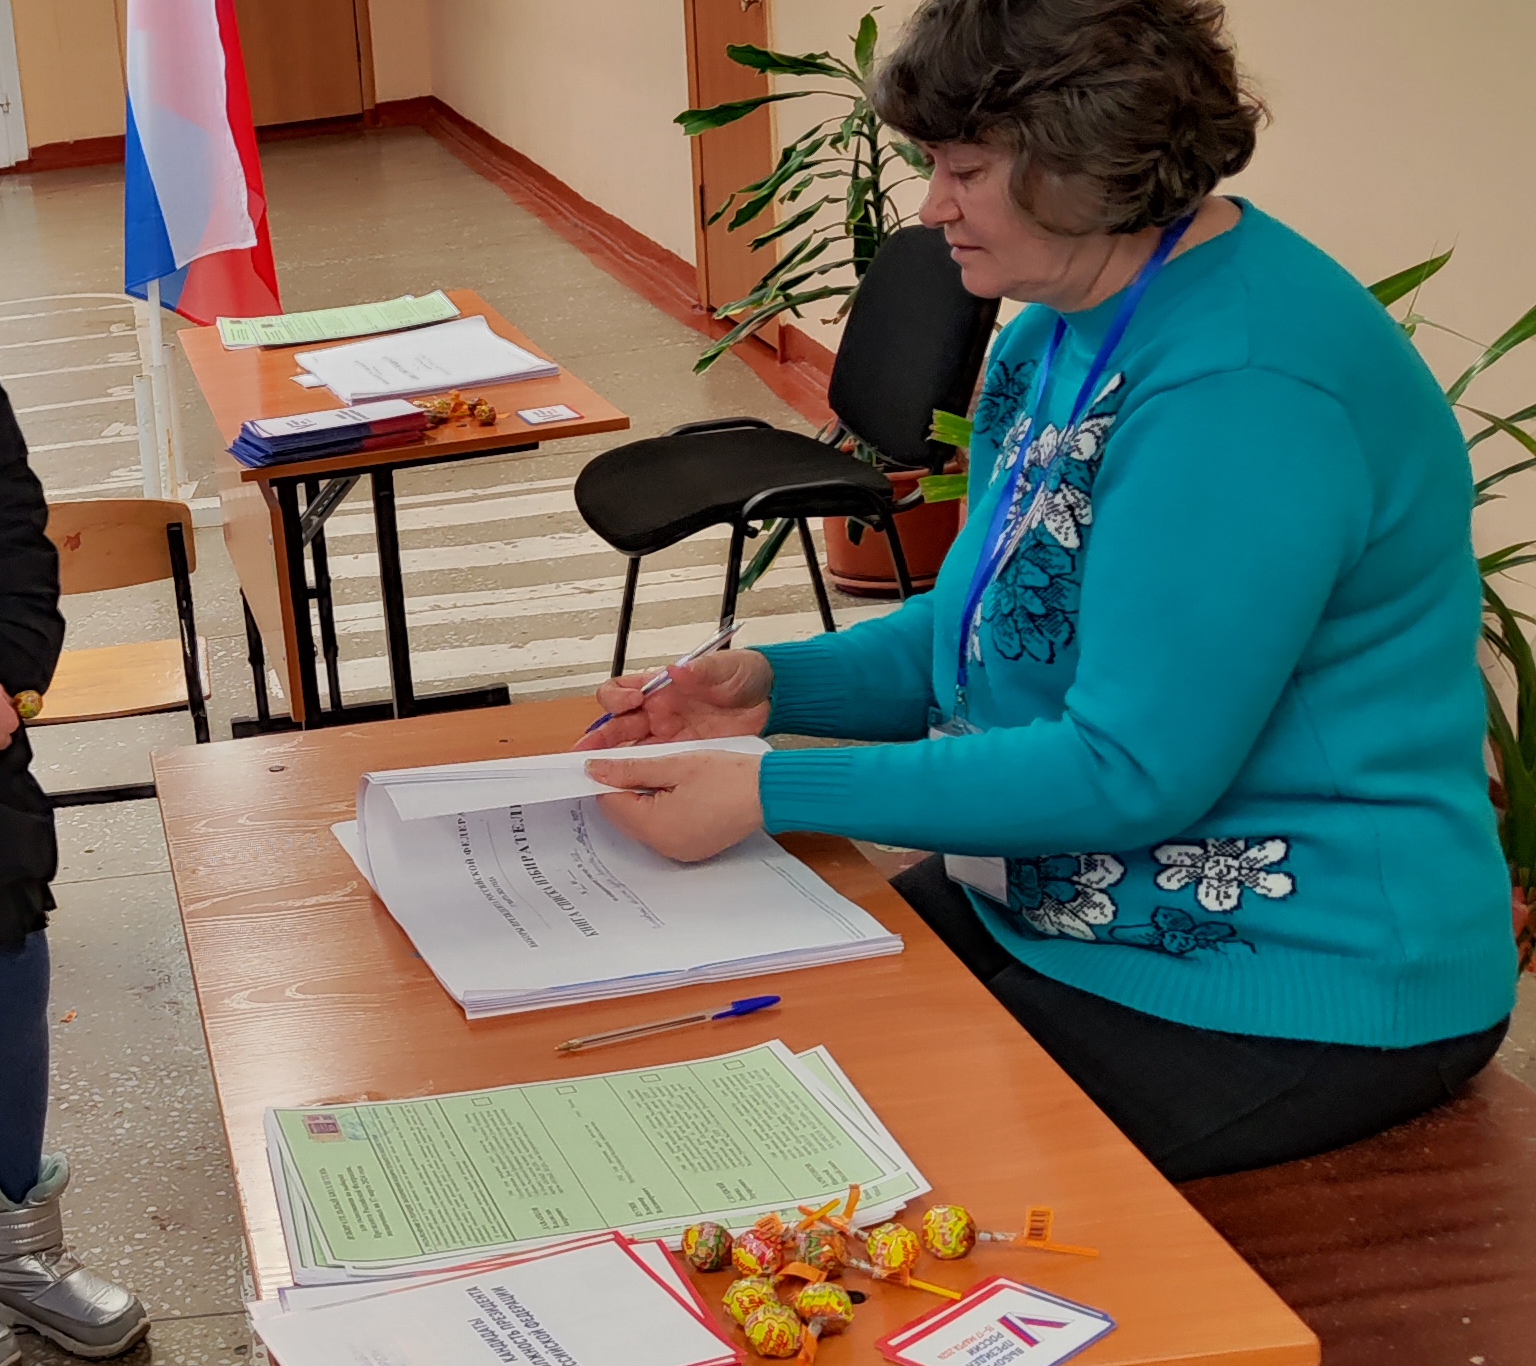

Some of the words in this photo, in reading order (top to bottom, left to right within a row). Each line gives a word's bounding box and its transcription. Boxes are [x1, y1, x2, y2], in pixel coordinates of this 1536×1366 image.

[465, 1285, 516, 1331] ПРЕЗИДЕНТА
[490, 1285, 541, 1329] ФЕДЕРАЦИИ
[467, 1317, 518, 1364] КАНДИДАТЫ
[954, 1335, 977, 1350] МАРТА
[966, 1331, 1005, 1357] РОССИИ
